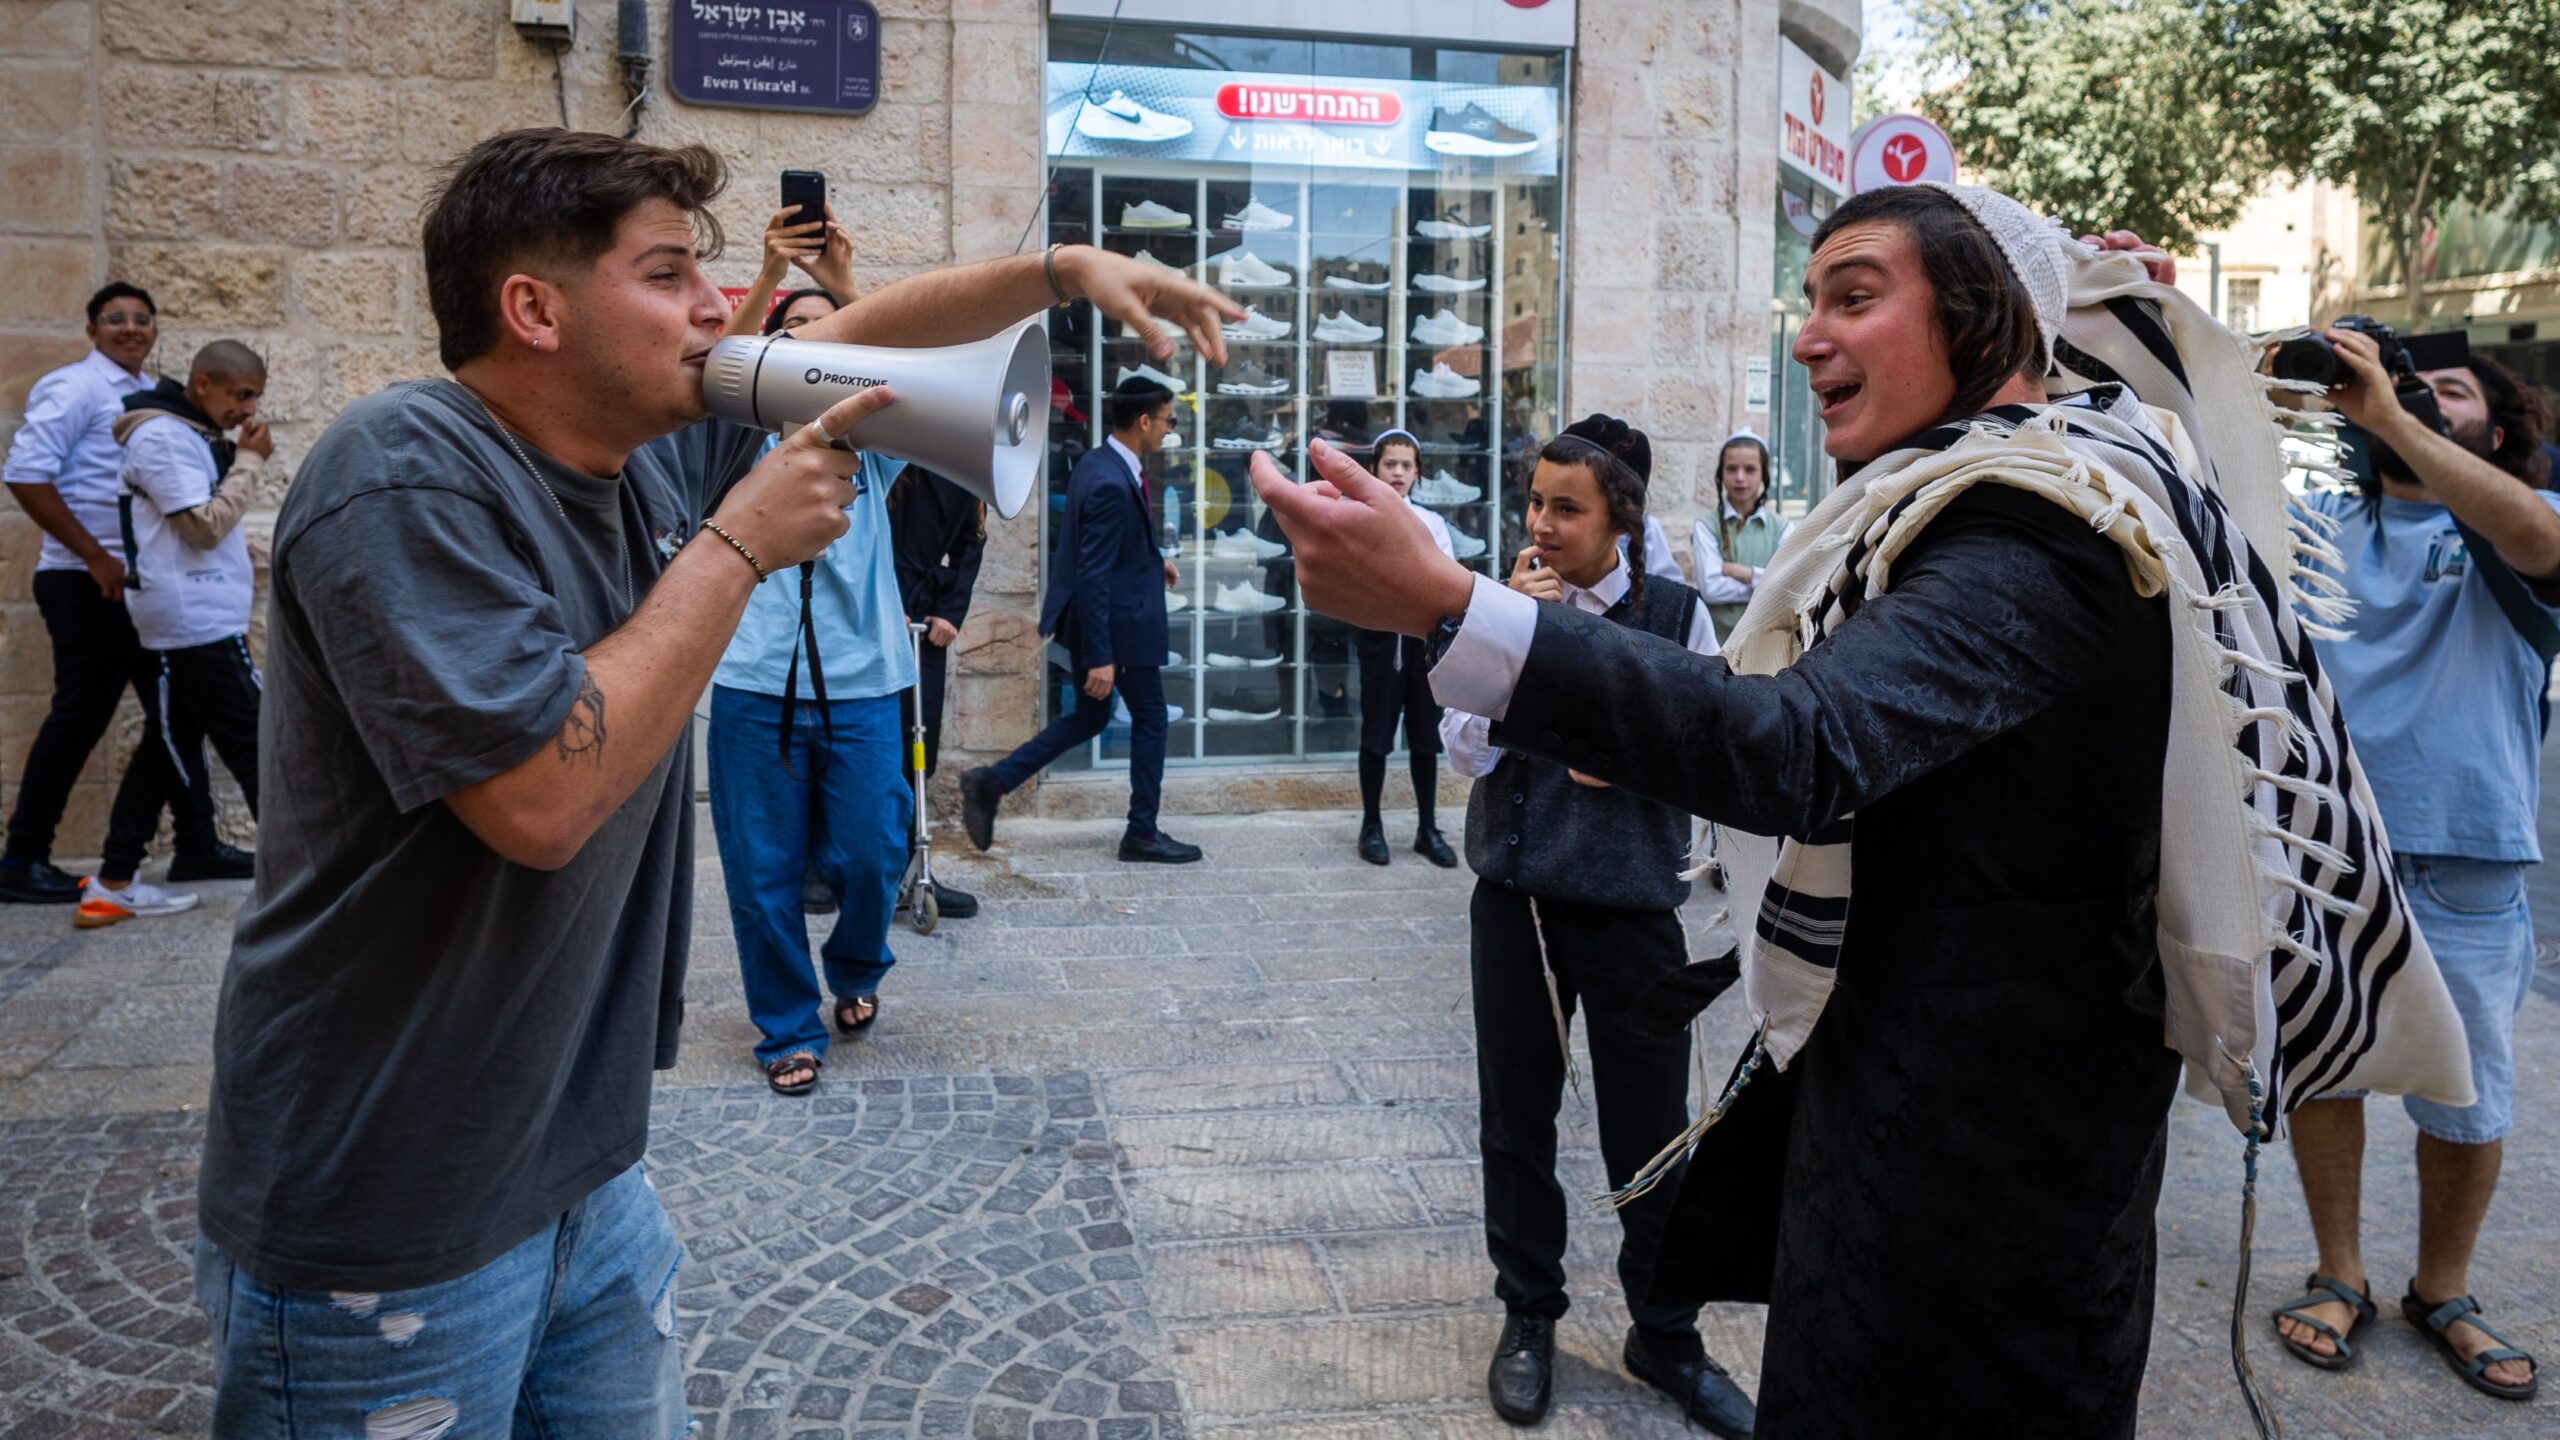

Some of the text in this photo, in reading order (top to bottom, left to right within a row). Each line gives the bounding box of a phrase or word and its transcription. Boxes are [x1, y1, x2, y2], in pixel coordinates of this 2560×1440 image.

[702, 75, 739, 91] Even
[742, 77, 797, 94] Yisra'el
[1238, 87, 1380, 119] התחדשנו!
[1253, 131, 1366, 154] בואו לראות
[1809, 129, 1844, 183] ספורט
